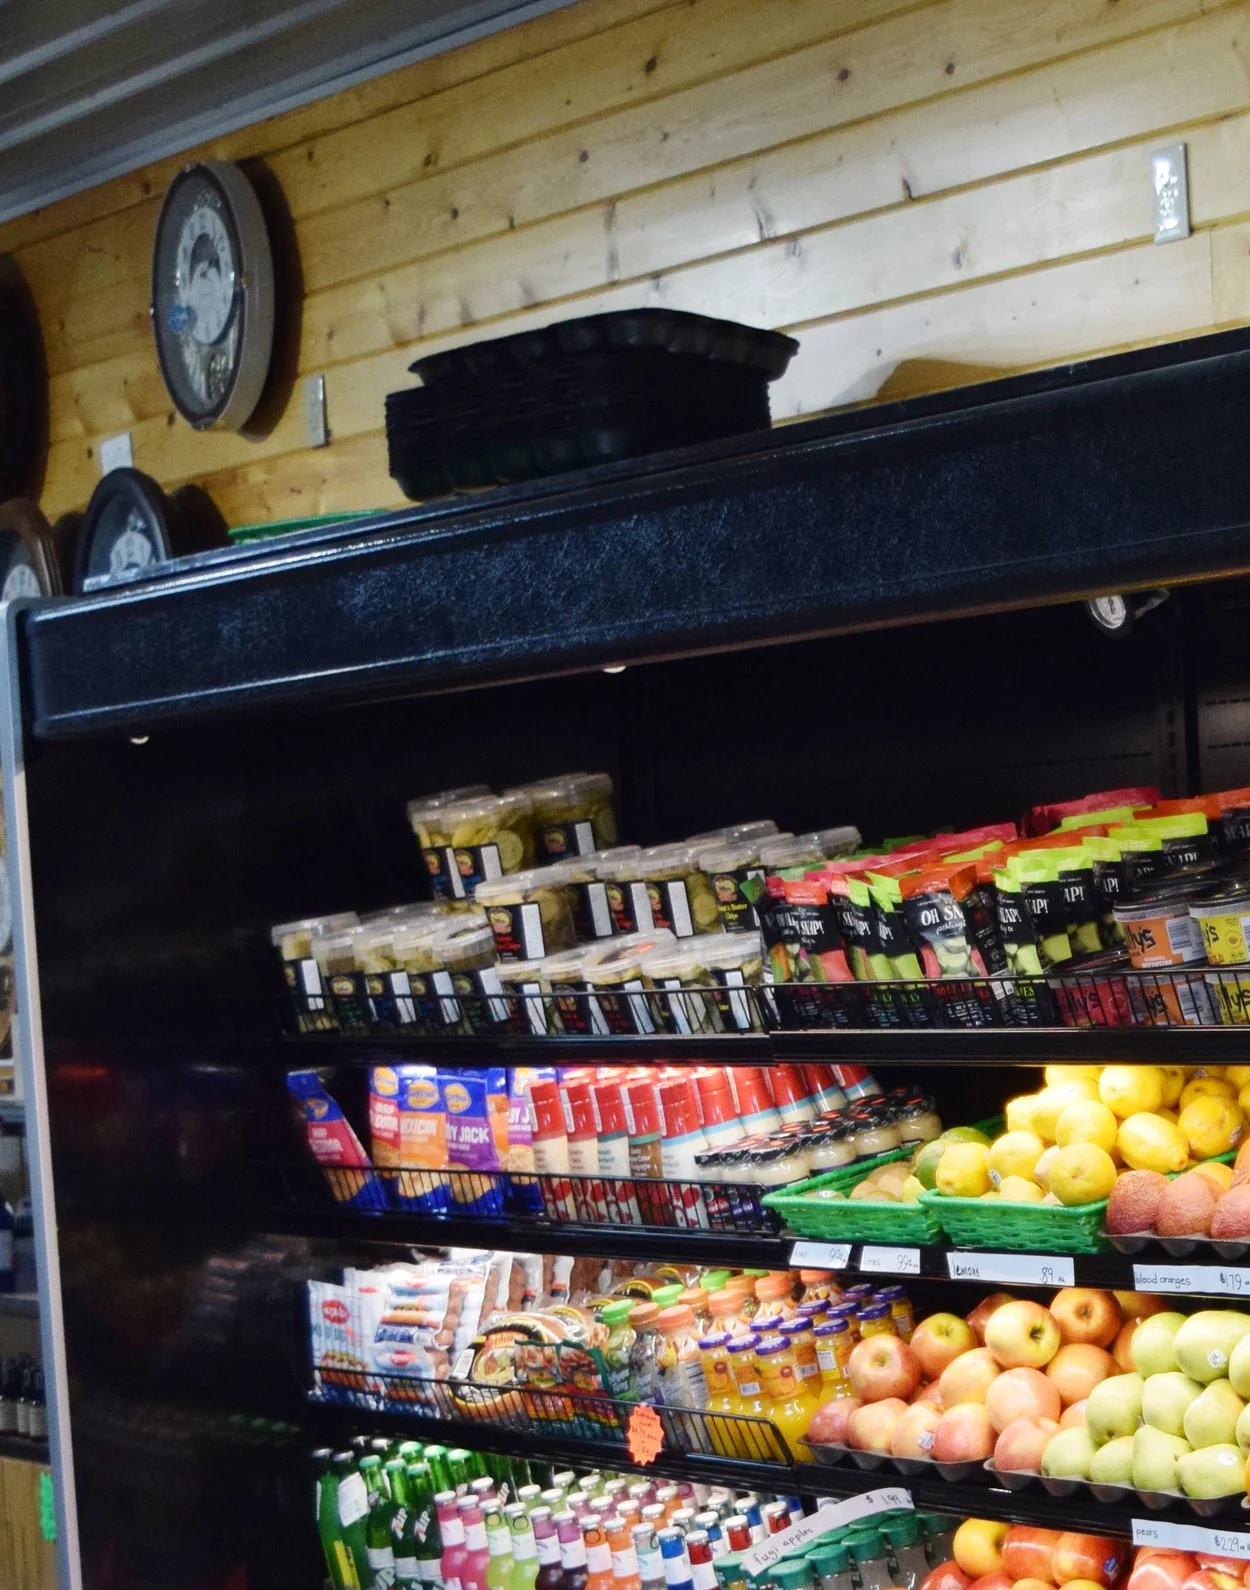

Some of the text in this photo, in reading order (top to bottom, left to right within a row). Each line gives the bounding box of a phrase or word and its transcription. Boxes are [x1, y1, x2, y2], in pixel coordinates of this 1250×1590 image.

[921, 910, 940, 926] OH
[459, 1126, 490, 1143] JACK
[953, 1258, 981, 1279] lemons
[1135, 1271, 1158, 1285] blood
[1159, 1275, 1192, 1288] oranges
[1135, 1526, 1159, 1541] pears
[753, 1546, 780, 1566] fugi
[783, 1526, 815, 1548] apples
